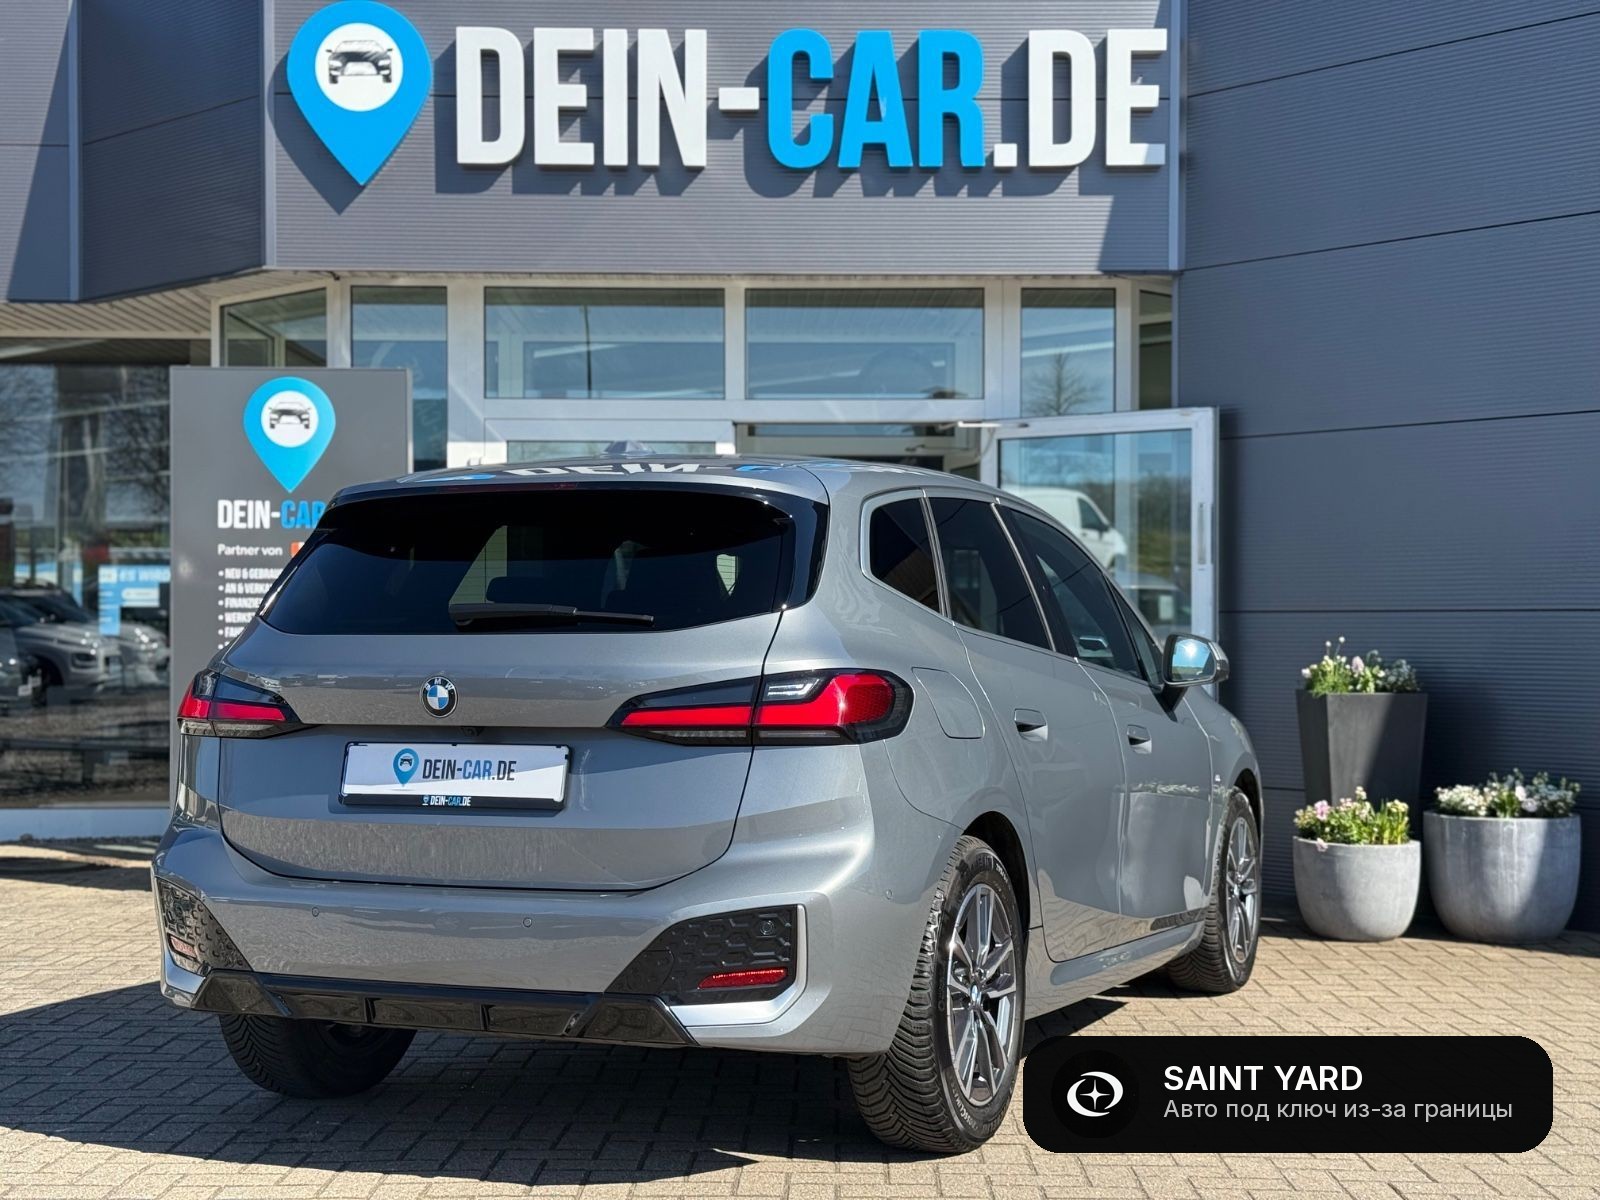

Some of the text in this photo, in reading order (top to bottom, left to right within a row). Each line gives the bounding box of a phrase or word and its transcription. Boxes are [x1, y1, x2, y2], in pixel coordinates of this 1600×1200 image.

[455, 26, 1168, 169] DEIN-CAR.DE
[217, 543, 283, 556] Partner von
[225, 568, 241, 579] NEU
[249, 568, 284, 579] GEBRAU
[225, 582, 236, 594] AN
[424, 677, 454, 690] BMW
[422, 758, 517, 782] DEIN-CAR.DE
[430, 795, 472, 807] DEIN-CAR.DE
